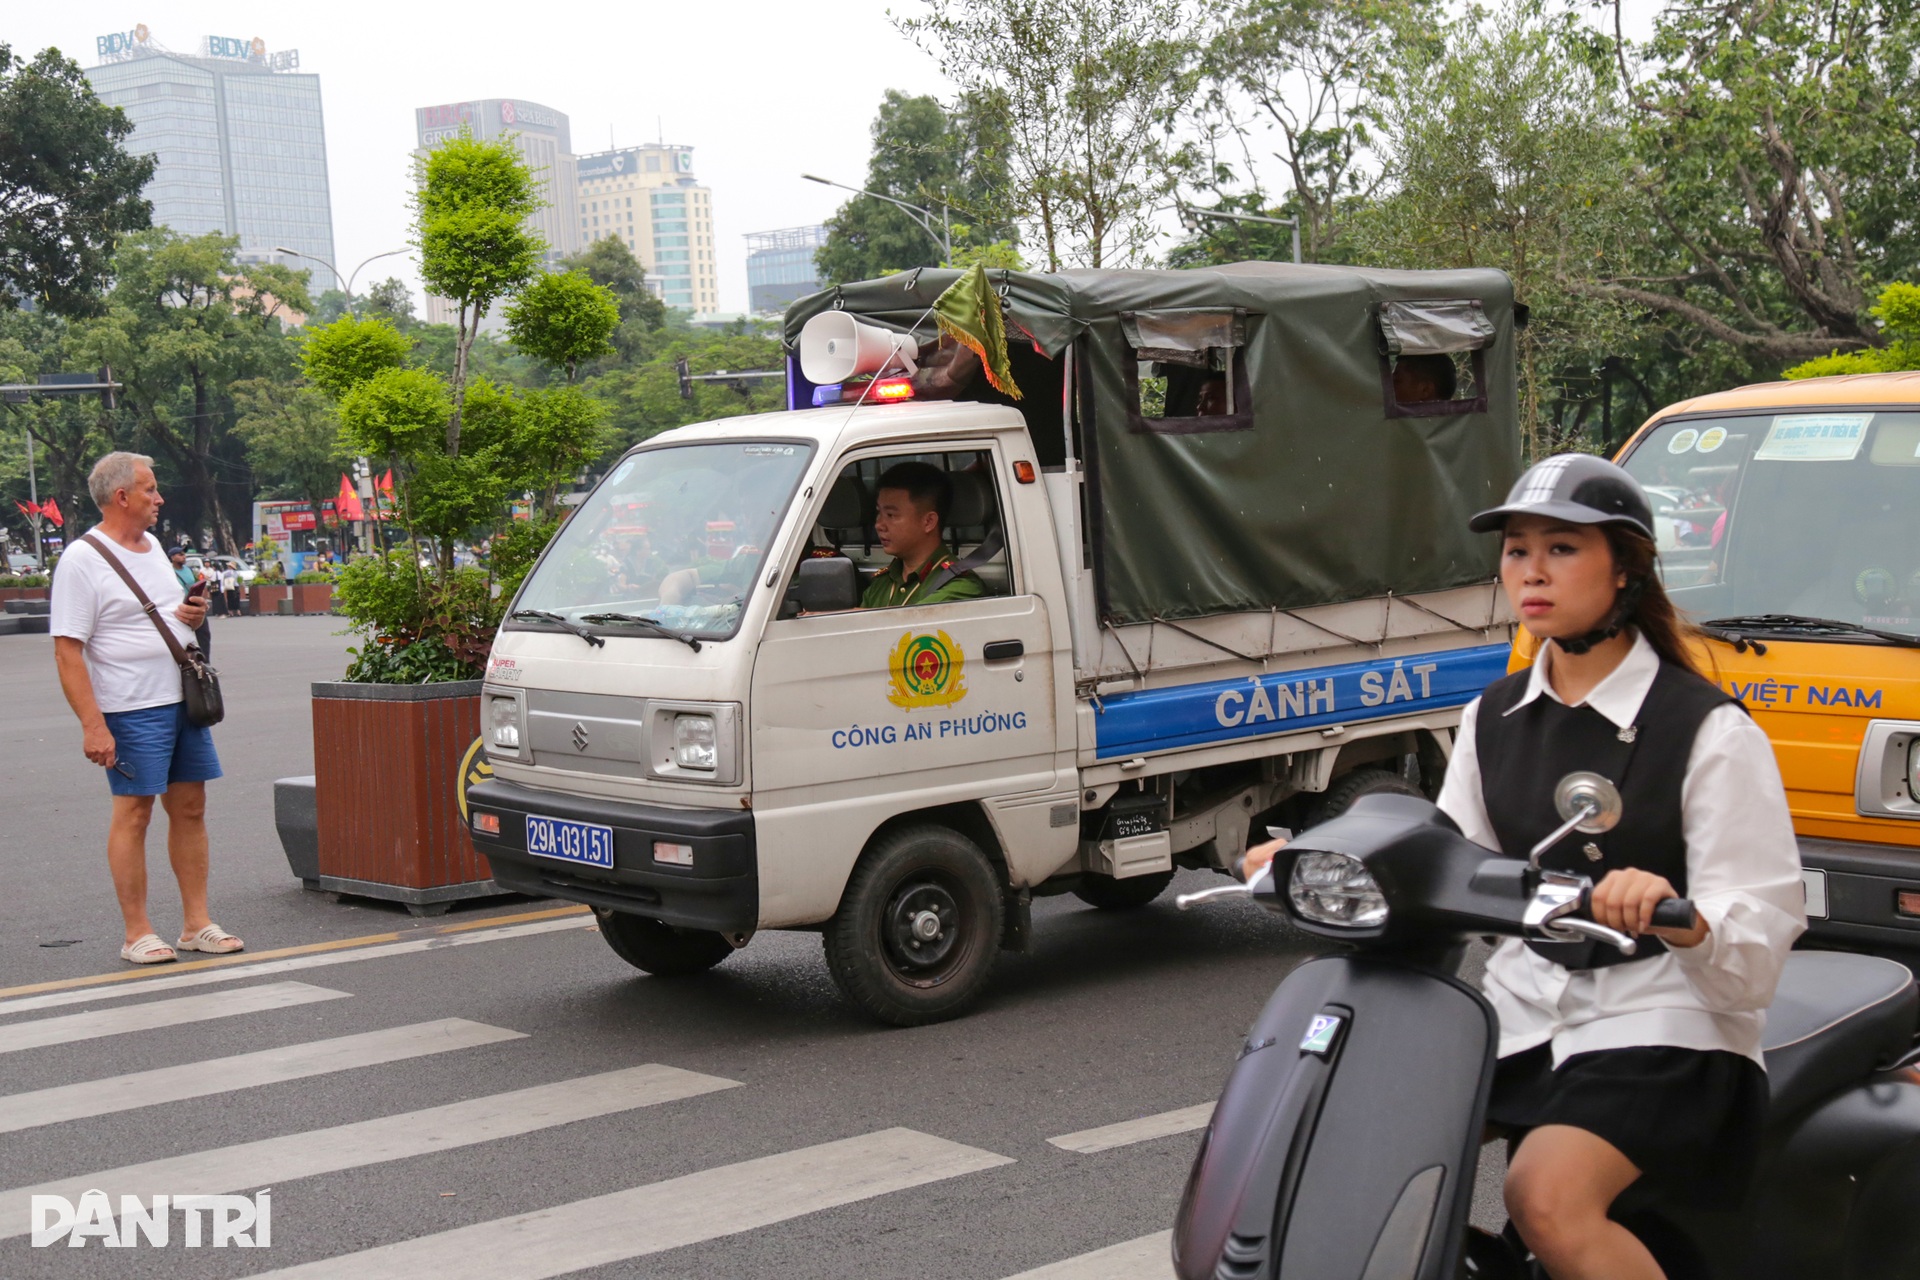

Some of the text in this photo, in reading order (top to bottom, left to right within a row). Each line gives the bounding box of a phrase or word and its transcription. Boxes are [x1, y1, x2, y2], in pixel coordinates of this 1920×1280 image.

[96, 29, 135, 56] BIDV
[208, 35, 253, 59] BIDV
[425, 102, 472, 127] BRG
[516, 108, 559, 129] SeABank
[493, 658, 516, 669] SUPER
[1215, 660, 1437, 728] CẢNH SÁT
[1730, 678, 1882, 709] VIỆT NAM
[832, 709, 1027, 749] CÔNG AN PHƯỜNG
[529, 820, 609, 863] 29A-031.51
[1306, 1018, 1328, 1038] P
